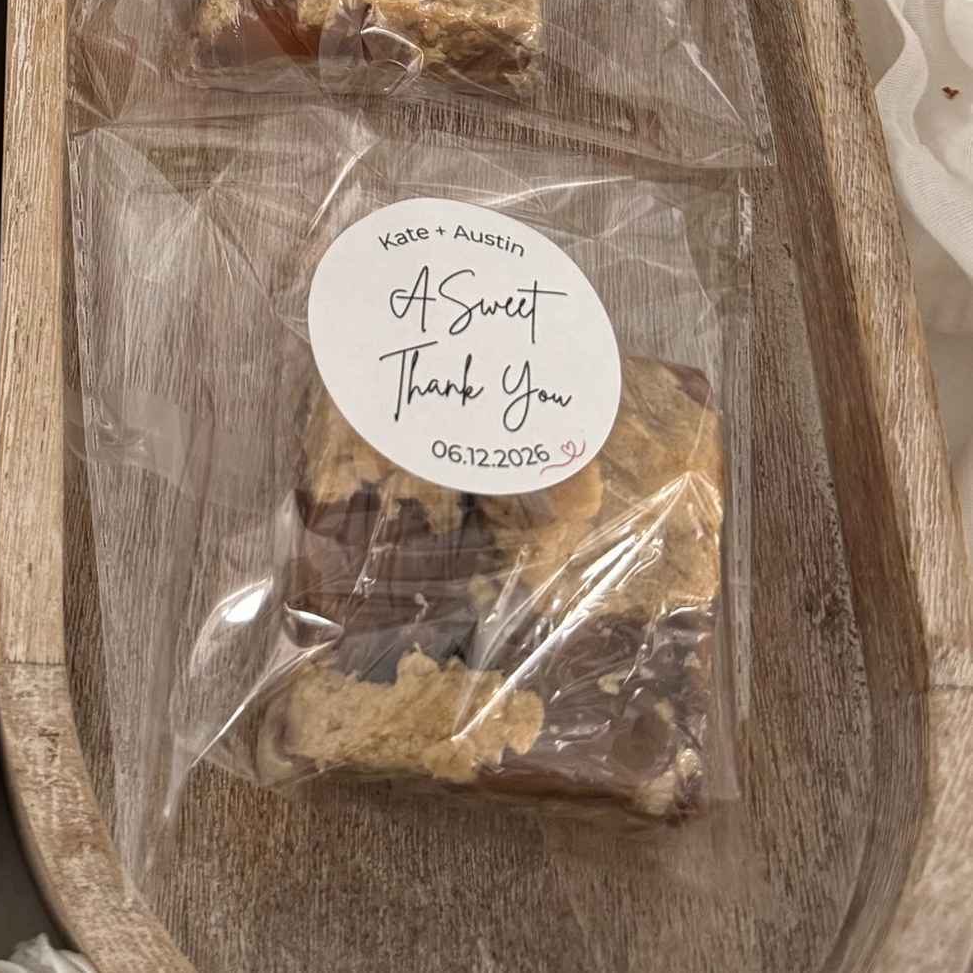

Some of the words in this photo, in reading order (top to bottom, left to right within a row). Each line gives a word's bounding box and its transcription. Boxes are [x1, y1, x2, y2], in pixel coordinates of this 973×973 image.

[378, 225, 430, 251] Kate
[453, 225, 525, 257] Austin
[389, 265, 437, 333] A
[438, 269, 568, 344] Sweet
[379, 341, 484, 422] Thank
[502, 360, 573, 432] You
[431, 440, 551, 469] 06.12.2026
